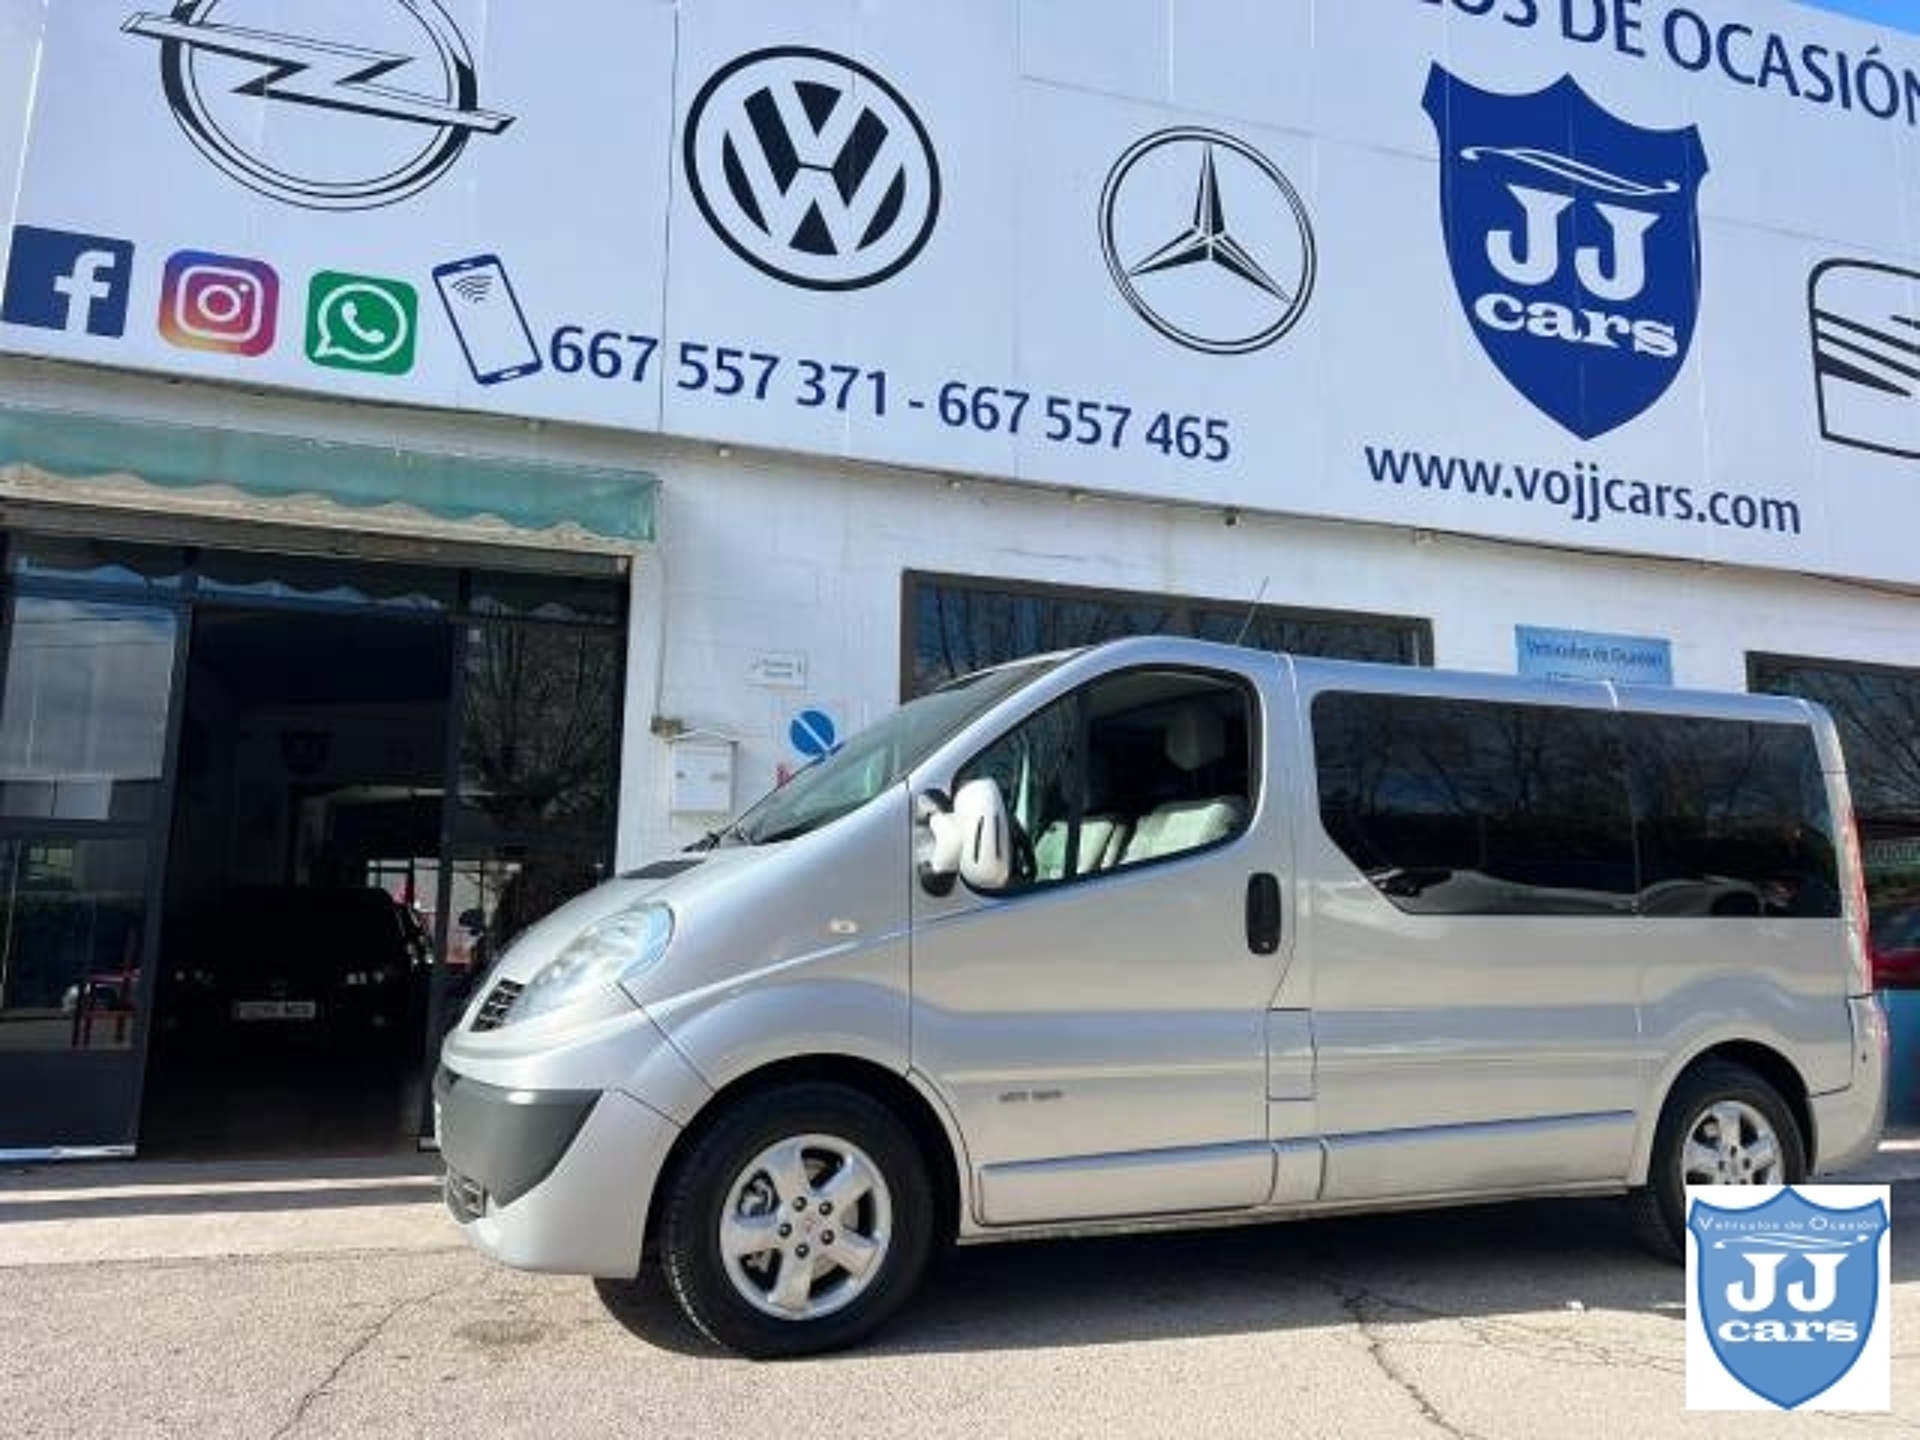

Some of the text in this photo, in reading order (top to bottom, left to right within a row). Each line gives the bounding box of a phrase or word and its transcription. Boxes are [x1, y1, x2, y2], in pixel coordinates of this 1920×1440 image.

[1560, 0, 1647, 58] DE
[1484, 182, 1660, 301] JJ
[1474, 292, 1679, 359] cars
[549, 325, 659, 383] 667
[675, 341, 780, 401] 557
[796, 359, 887, 417] 371
[938, 380, 1031, 434] 667
[1045, 395, 1132, 449] 557
[1144, 411, 1231, 463] 465
[1364, 446, 1801, 535] www.vojjcars.com
